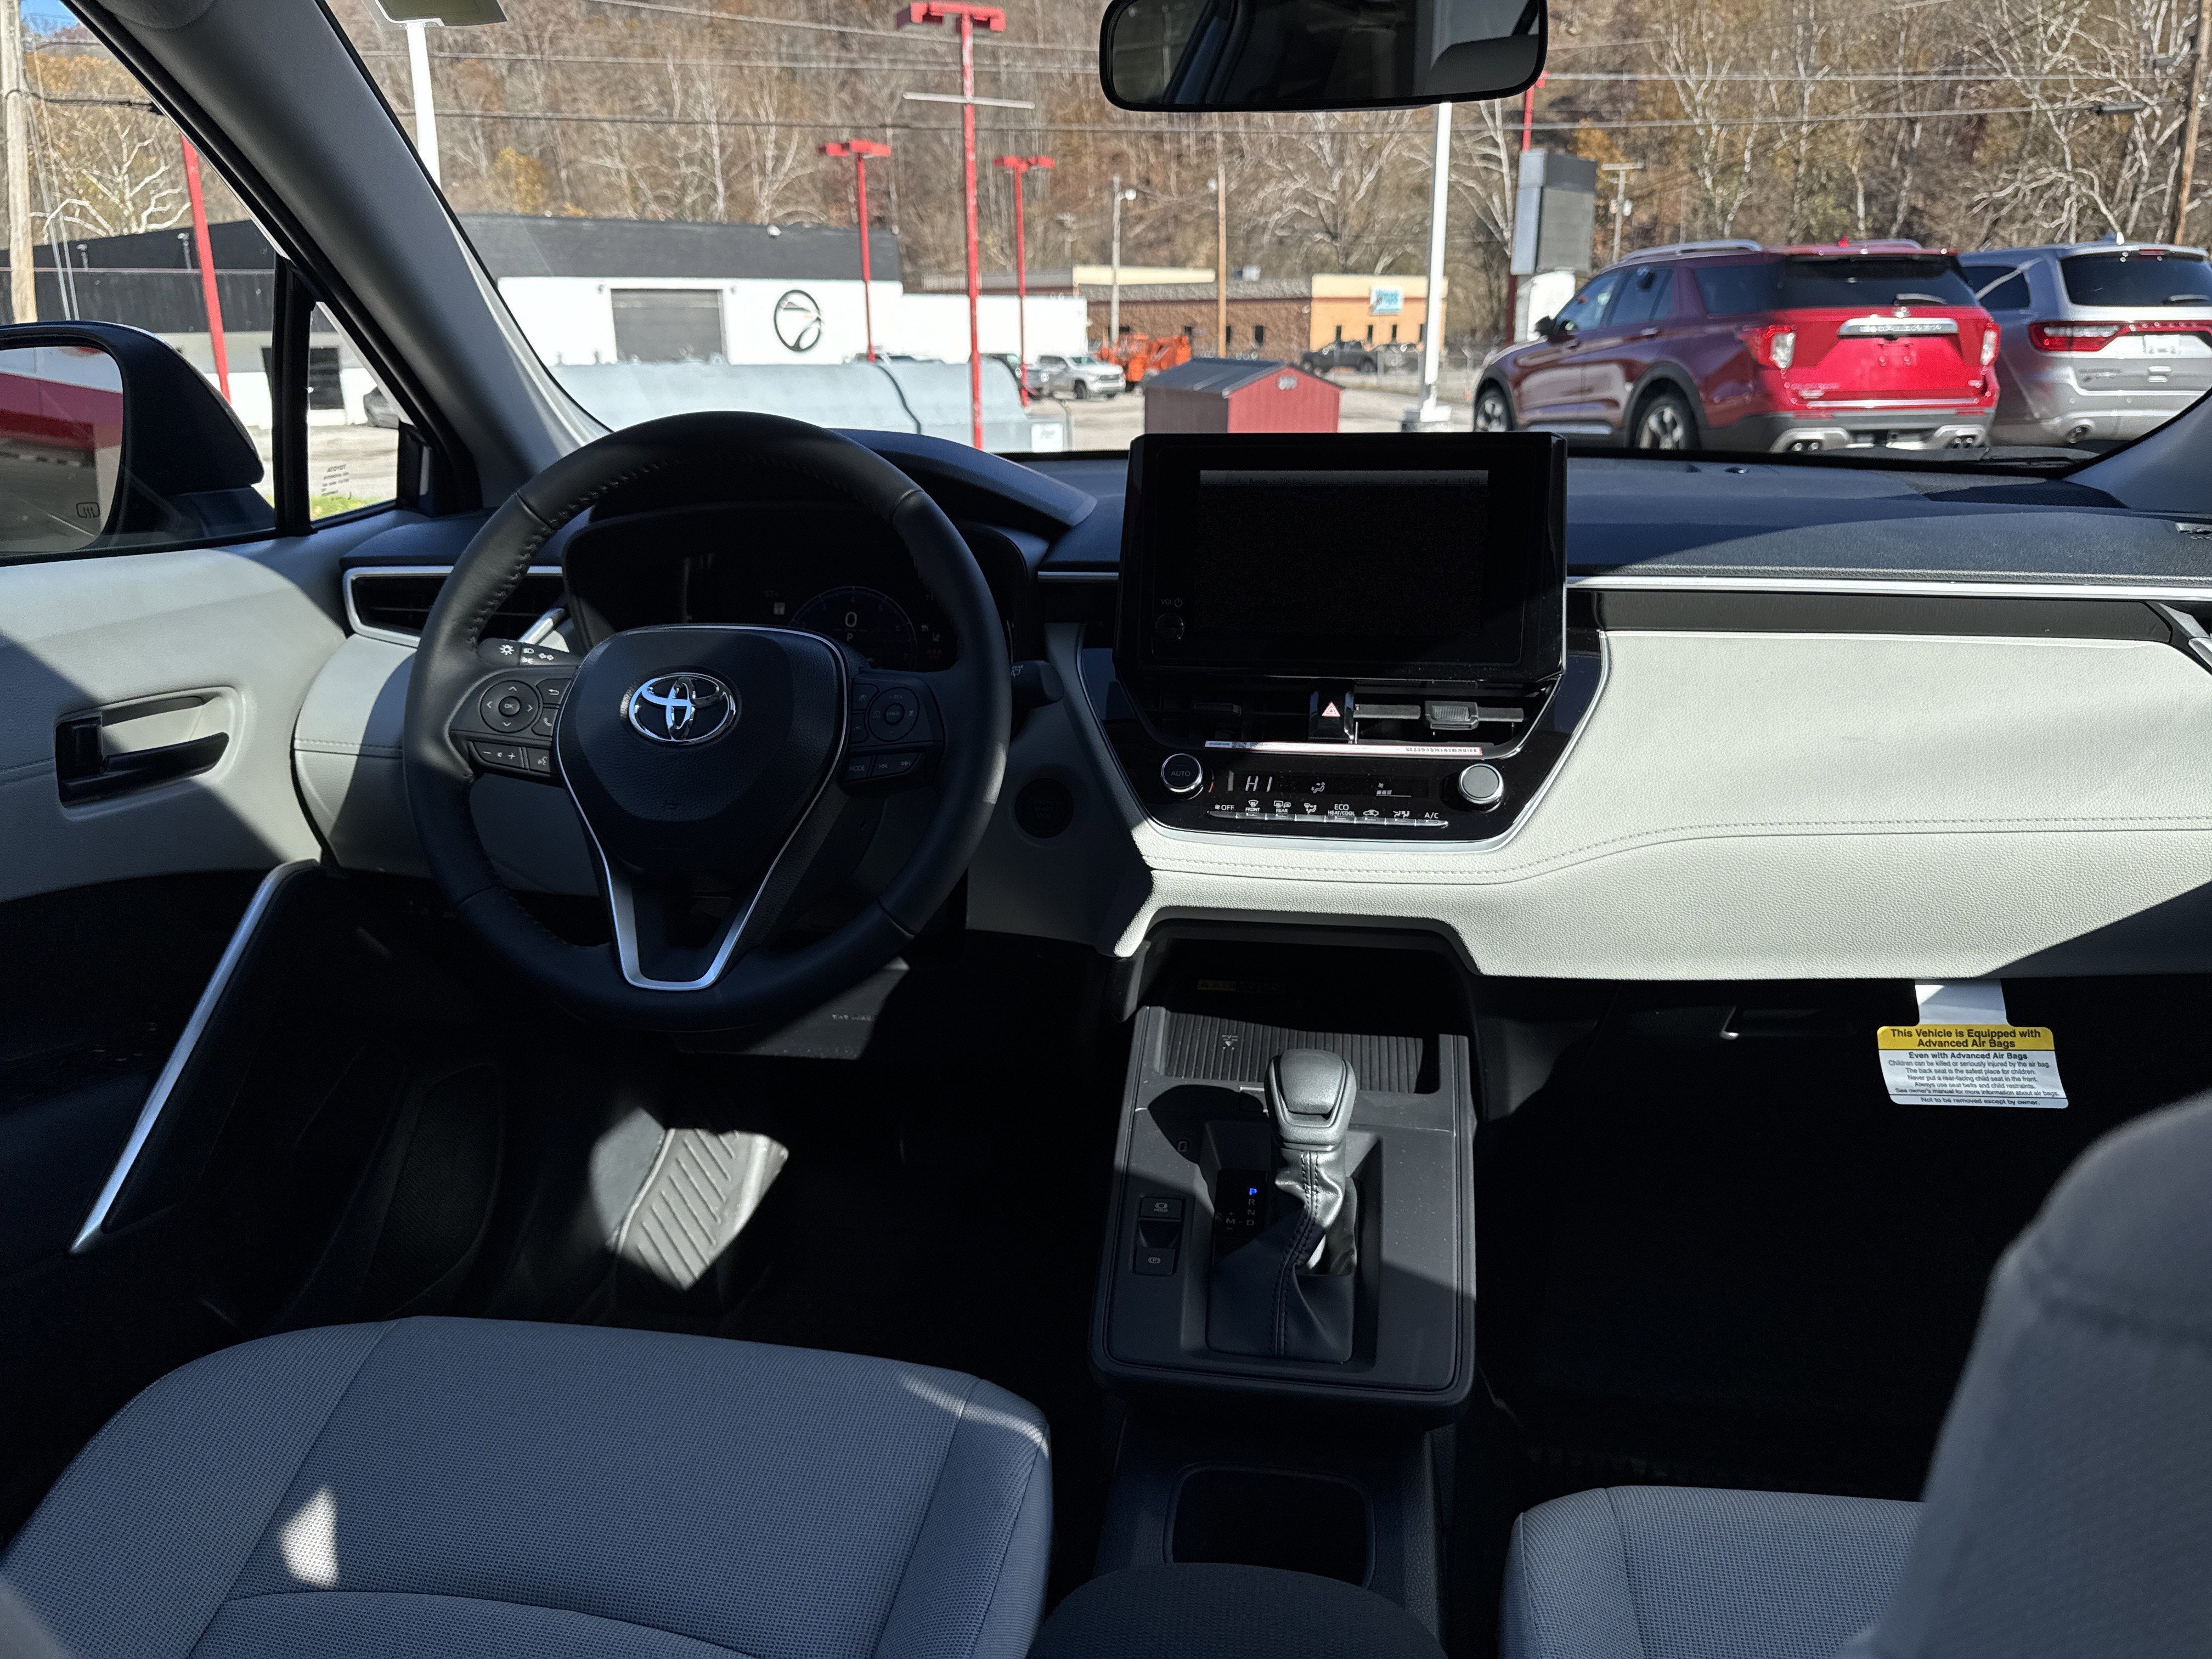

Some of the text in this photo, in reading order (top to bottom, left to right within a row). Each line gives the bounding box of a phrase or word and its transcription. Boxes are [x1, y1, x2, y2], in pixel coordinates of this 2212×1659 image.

[844, 611, 858, 628] 0
[847, 633, 854, 642] P
[1245, 775, 1272, 792] HI
[1890, 1029, 2041, 1040] This Vehicle is Equipped with
[1917, 1039, 2016, 1049] Advanced Air Bags
[2007, 1052, 2028, 1060] Bags
